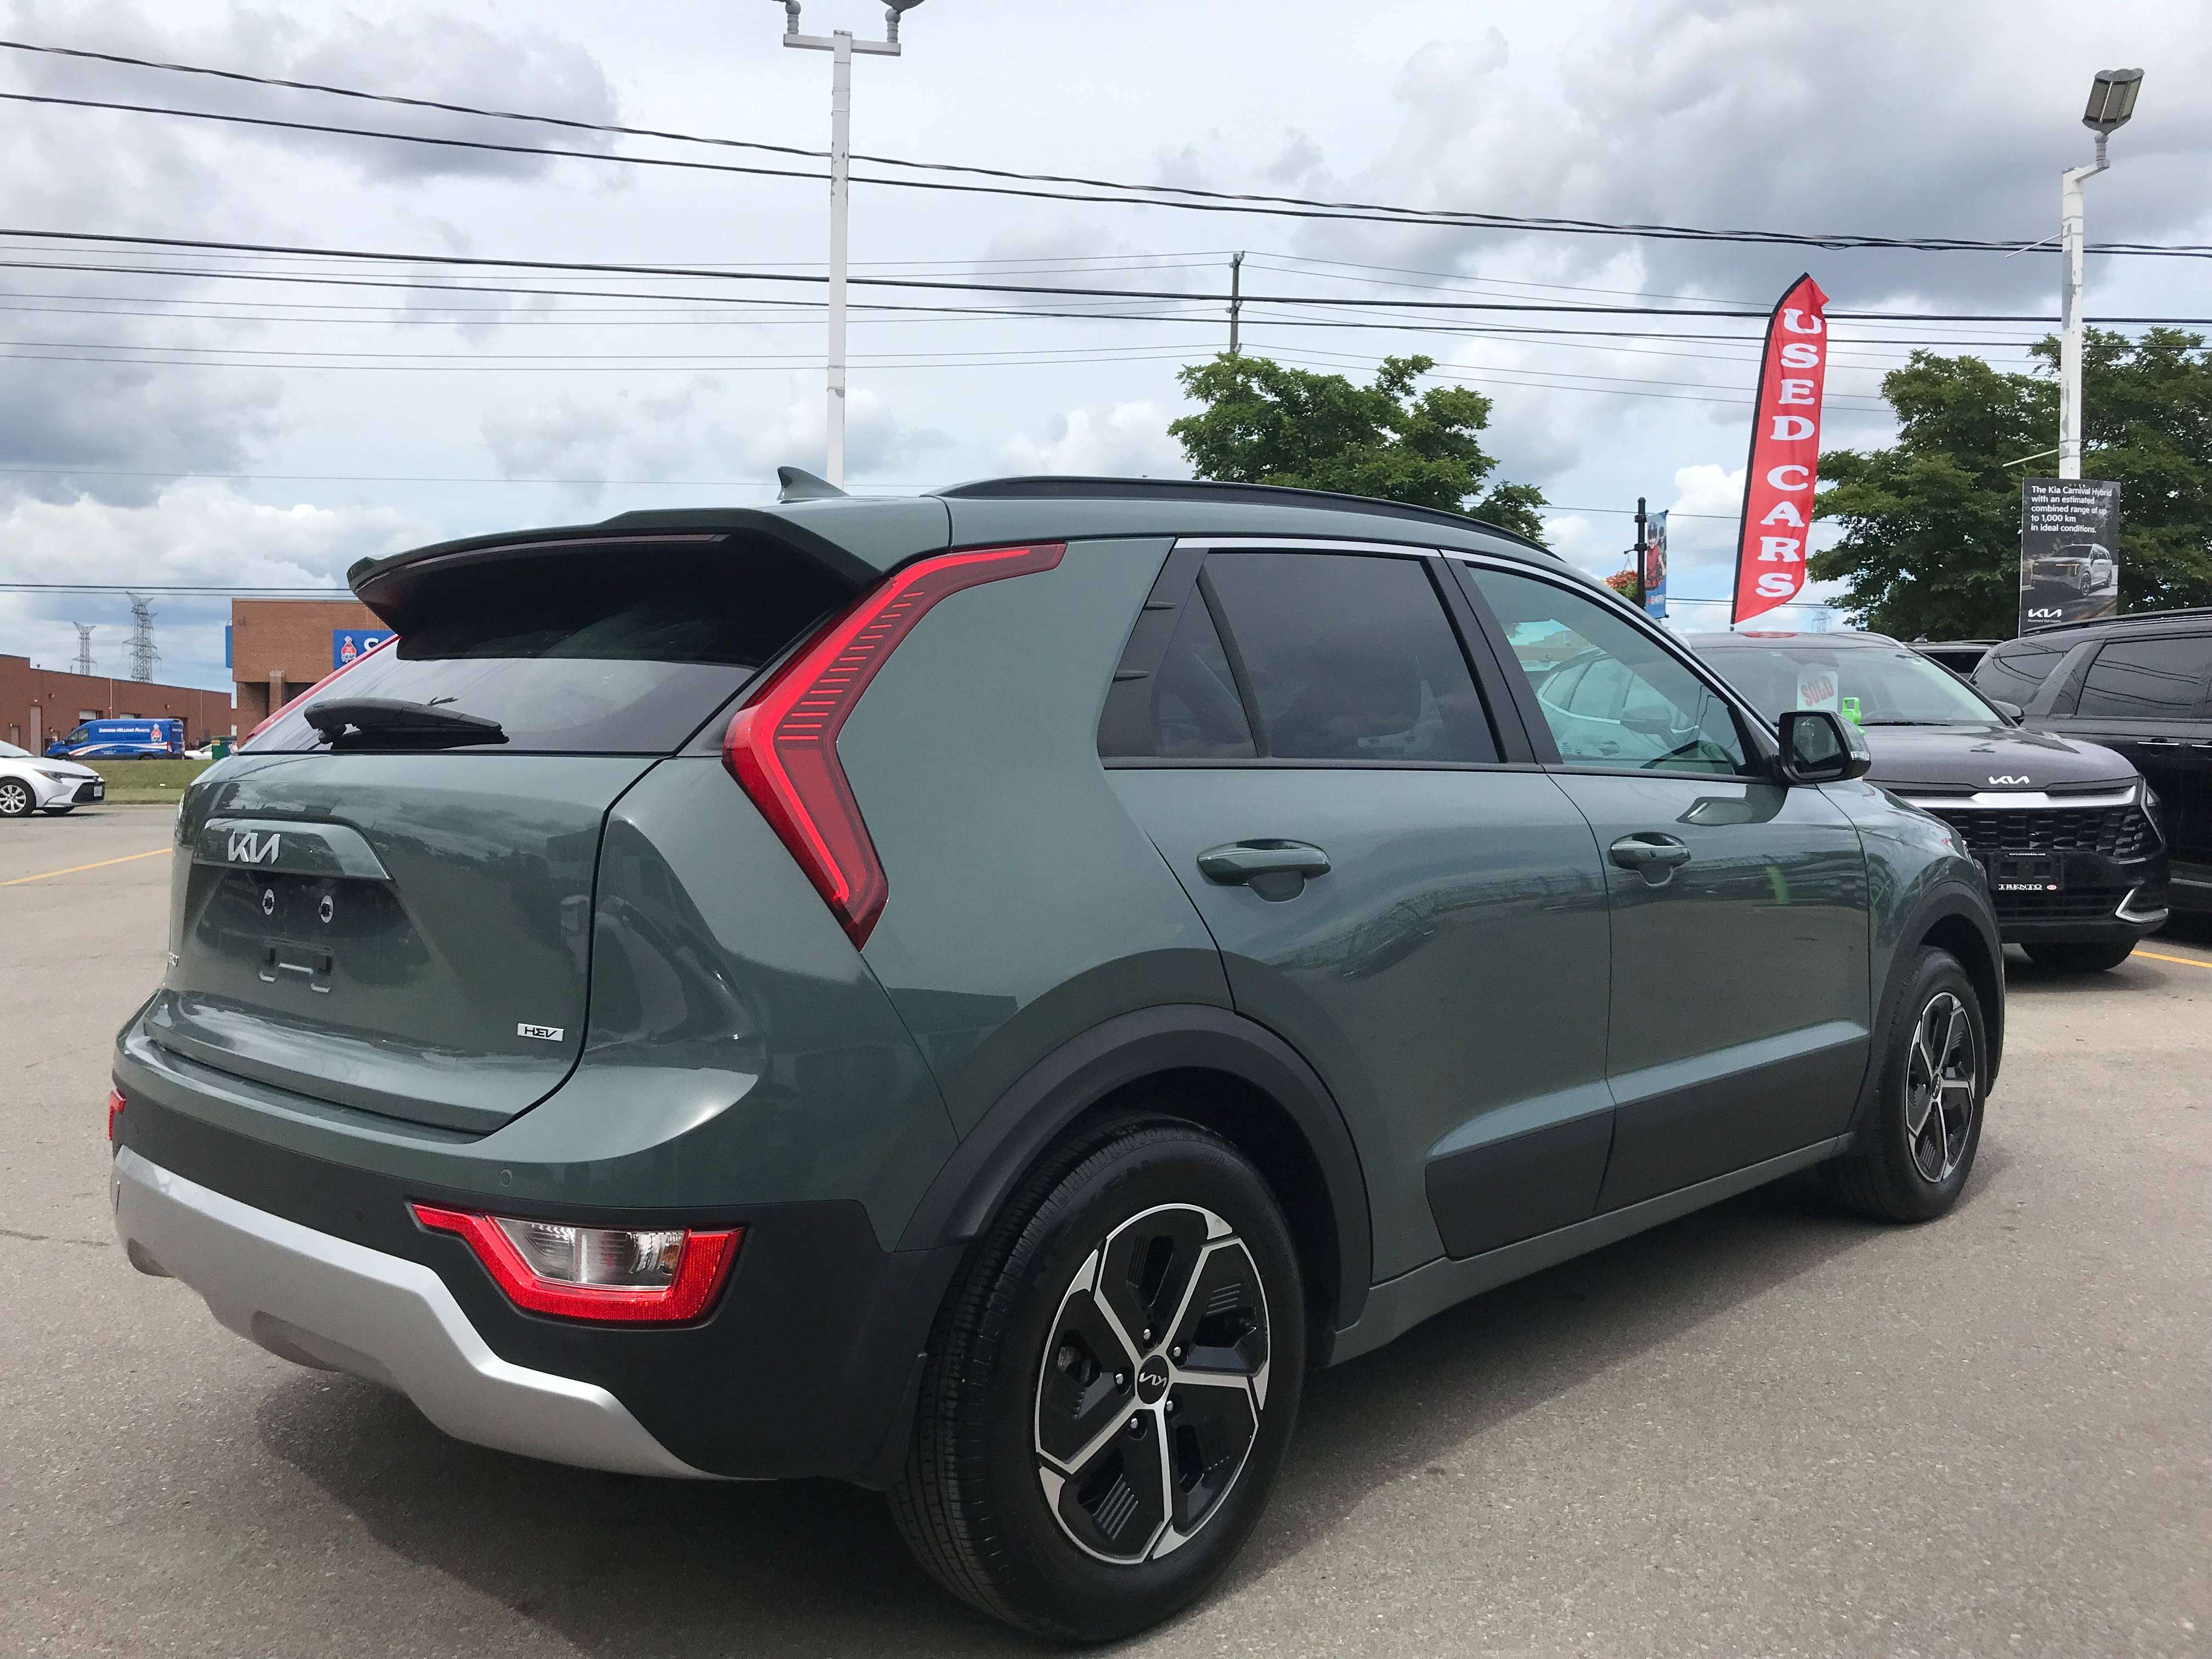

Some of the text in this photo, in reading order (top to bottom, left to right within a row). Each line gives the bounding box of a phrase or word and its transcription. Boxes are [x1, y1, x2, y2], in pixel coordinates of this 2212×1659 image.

[1770, 308, 1822, 441] USED
[2062, 487, 2091, 495] Carnival
[2092, 488, 2112, 497] Hybrid
[2062, 496, 2095, 504] estimated
[2041, 514, 2063, 522] 1,000
[1756, 465, 1809, 597] CARS
[2028, 608, 2062, 618] KIA
[1801, 675, 1835, 707] SOLD
[1988, 775, 2030, 785] KIA
[228, 831, 281, 865] KIA
[524, 1026, 557, 1037] HEV
[1139, 1372, 1167, 1387] KIA
